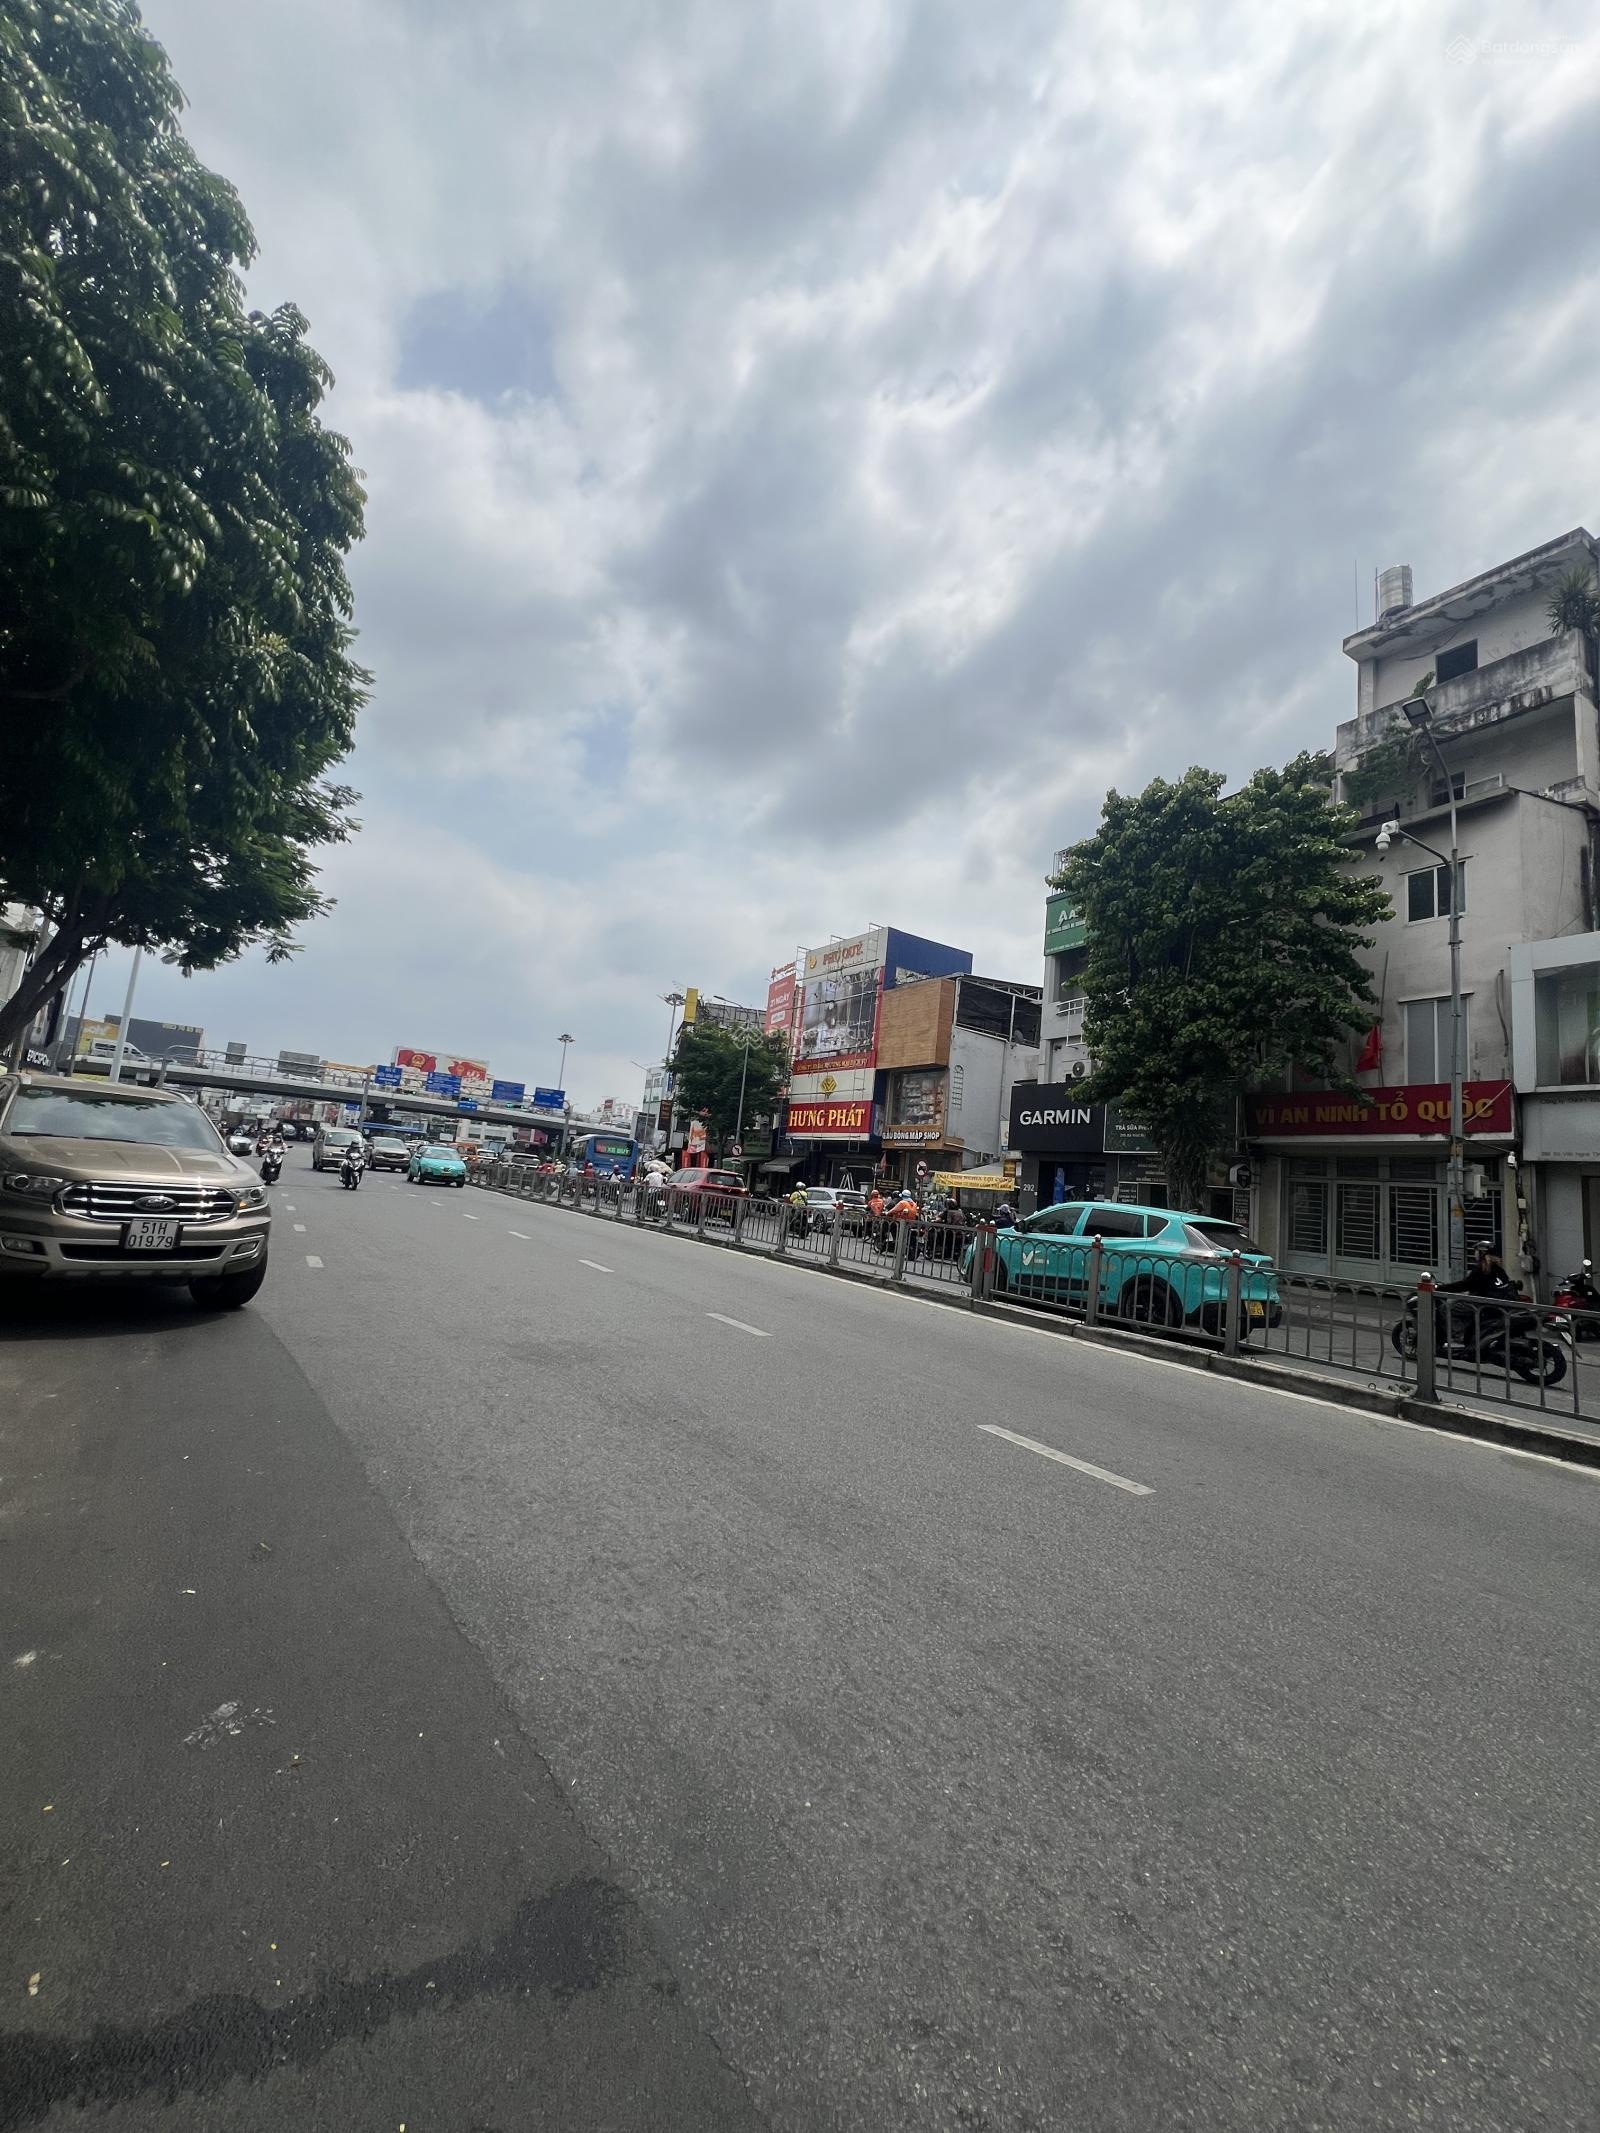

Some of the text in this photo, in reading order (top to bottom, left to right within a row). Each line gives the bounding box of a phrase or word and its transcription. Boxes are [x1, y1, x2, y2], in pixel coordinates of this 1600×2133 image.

[1256, 1089, 1496, 1125] VÌ AN NINH TỔ QUỐC
[789, 1103, 865, 1127] HƯNG PHÁT
[1019, 1108, 1091, 1125] GARMIN
[923, 1131, 941, 1140] SHOP
[1023, 1183, 1035, 1192] 292
[141, 1222, 168, 1235] 51H
[127, 1235, 173, 1248] 019.79
